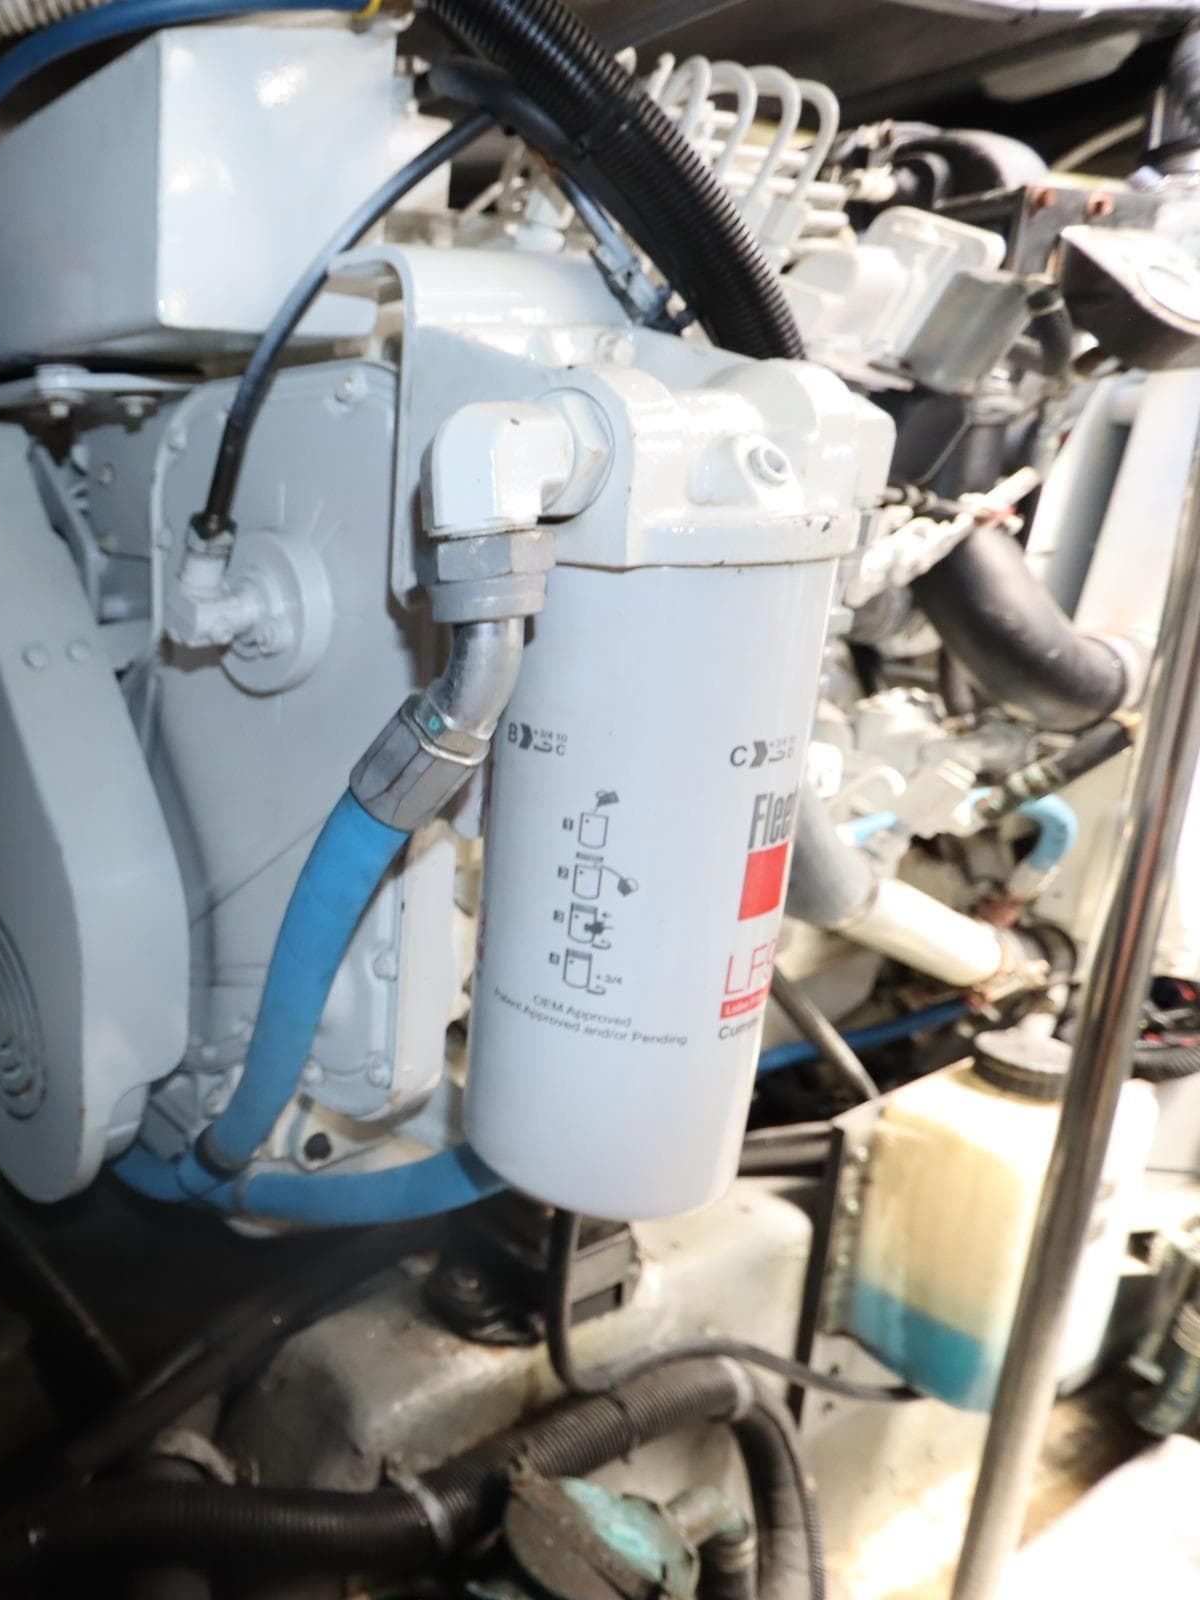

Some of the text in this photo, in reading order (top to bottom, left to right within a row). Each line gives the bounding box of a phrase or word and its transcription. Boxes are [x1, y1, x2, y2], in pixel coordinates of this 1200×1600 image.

[508, 721, 519, 743] B
[730, 745, 748, 767] C
[748, 791, 798, 850] Flee
[523, 1005, 580, 1032] Approved
[583, 1024, 628, 1041] and/or
[631, 1029, 689, 1047] Pending
[534, 994, 633, 1028] OEM Approved
